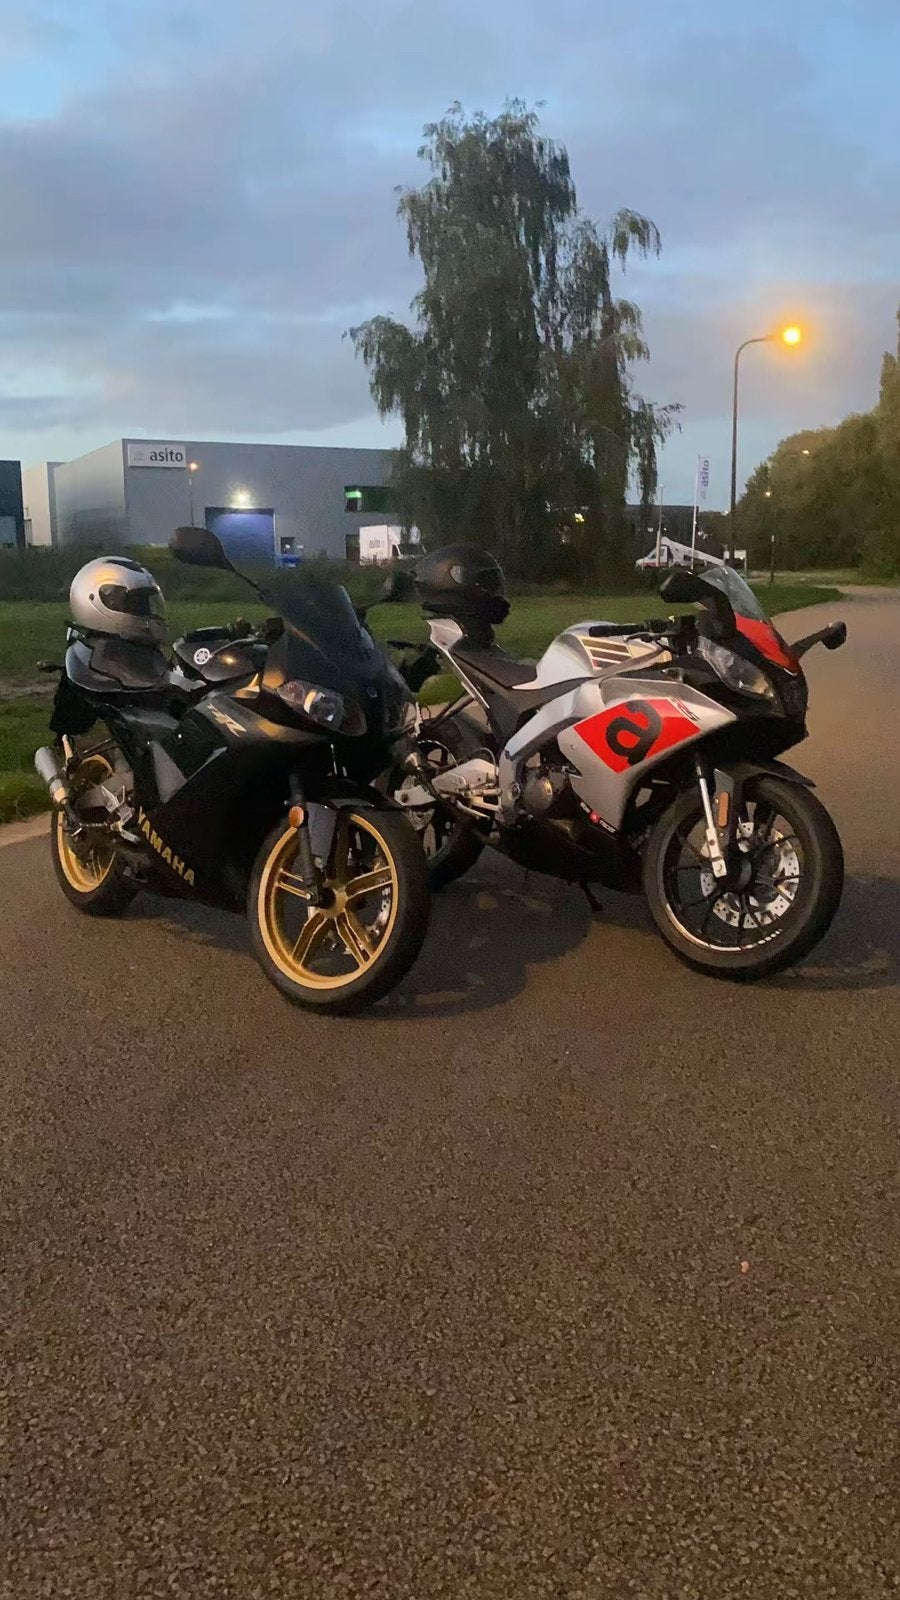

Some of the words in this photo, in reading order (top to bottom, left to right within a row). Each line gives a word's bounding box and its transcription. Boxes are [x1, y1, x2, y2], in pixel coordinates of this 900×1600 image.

[149, 447, 184, 463] asito
[700, 459, 710, 487] asito
[137, 805, 195, 887] YAMAHA
